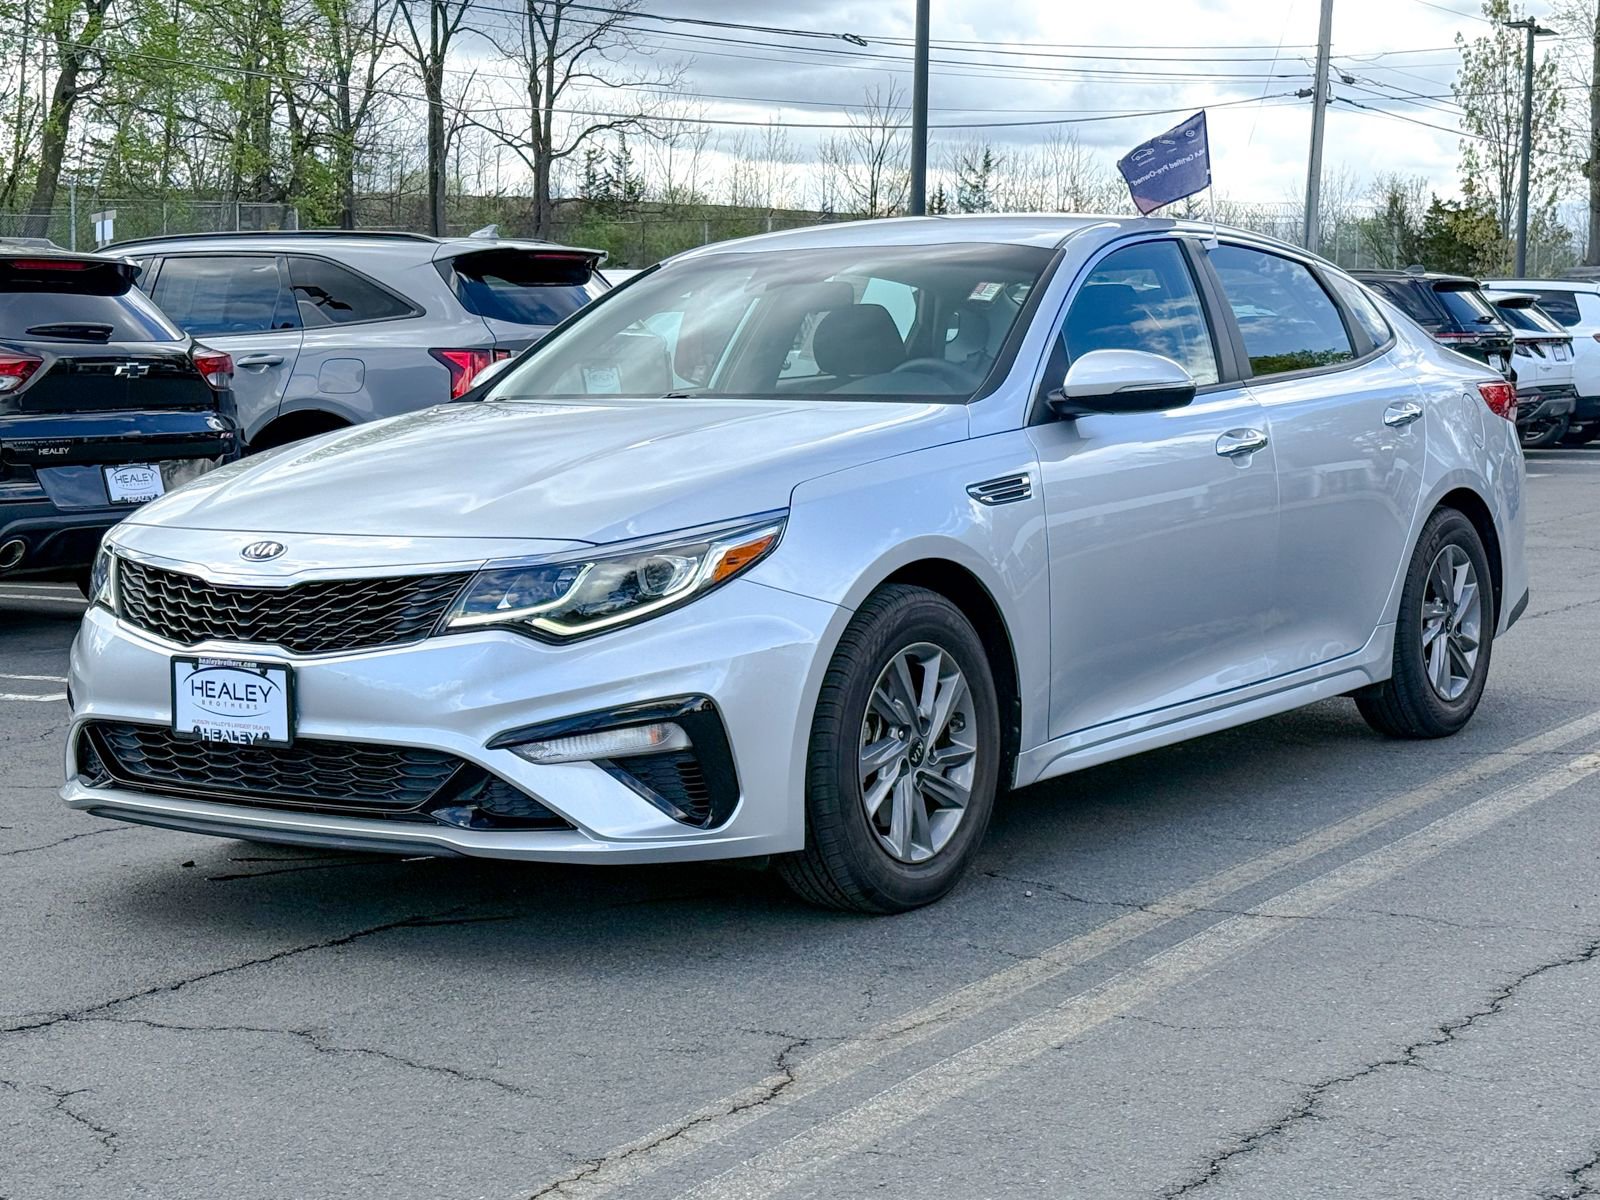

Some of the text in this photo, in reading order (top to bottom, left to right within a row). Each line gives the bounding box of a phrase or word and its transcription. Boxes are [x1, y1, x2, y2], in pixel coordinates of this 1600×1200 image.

[38, 447, 70, 455] HEALEY
[114, 473, 154, 484] HEALEY
[244, 541, 279, 559] KIA
[198, 658, 258, 668] healeybrothers.com
[191, 679, 273, 703] HEALEY
[201, 699, 258, 710] BROTHERS
[202, 728, 259, 745] HEALEY
[911, 742, 924, 762] KIA
